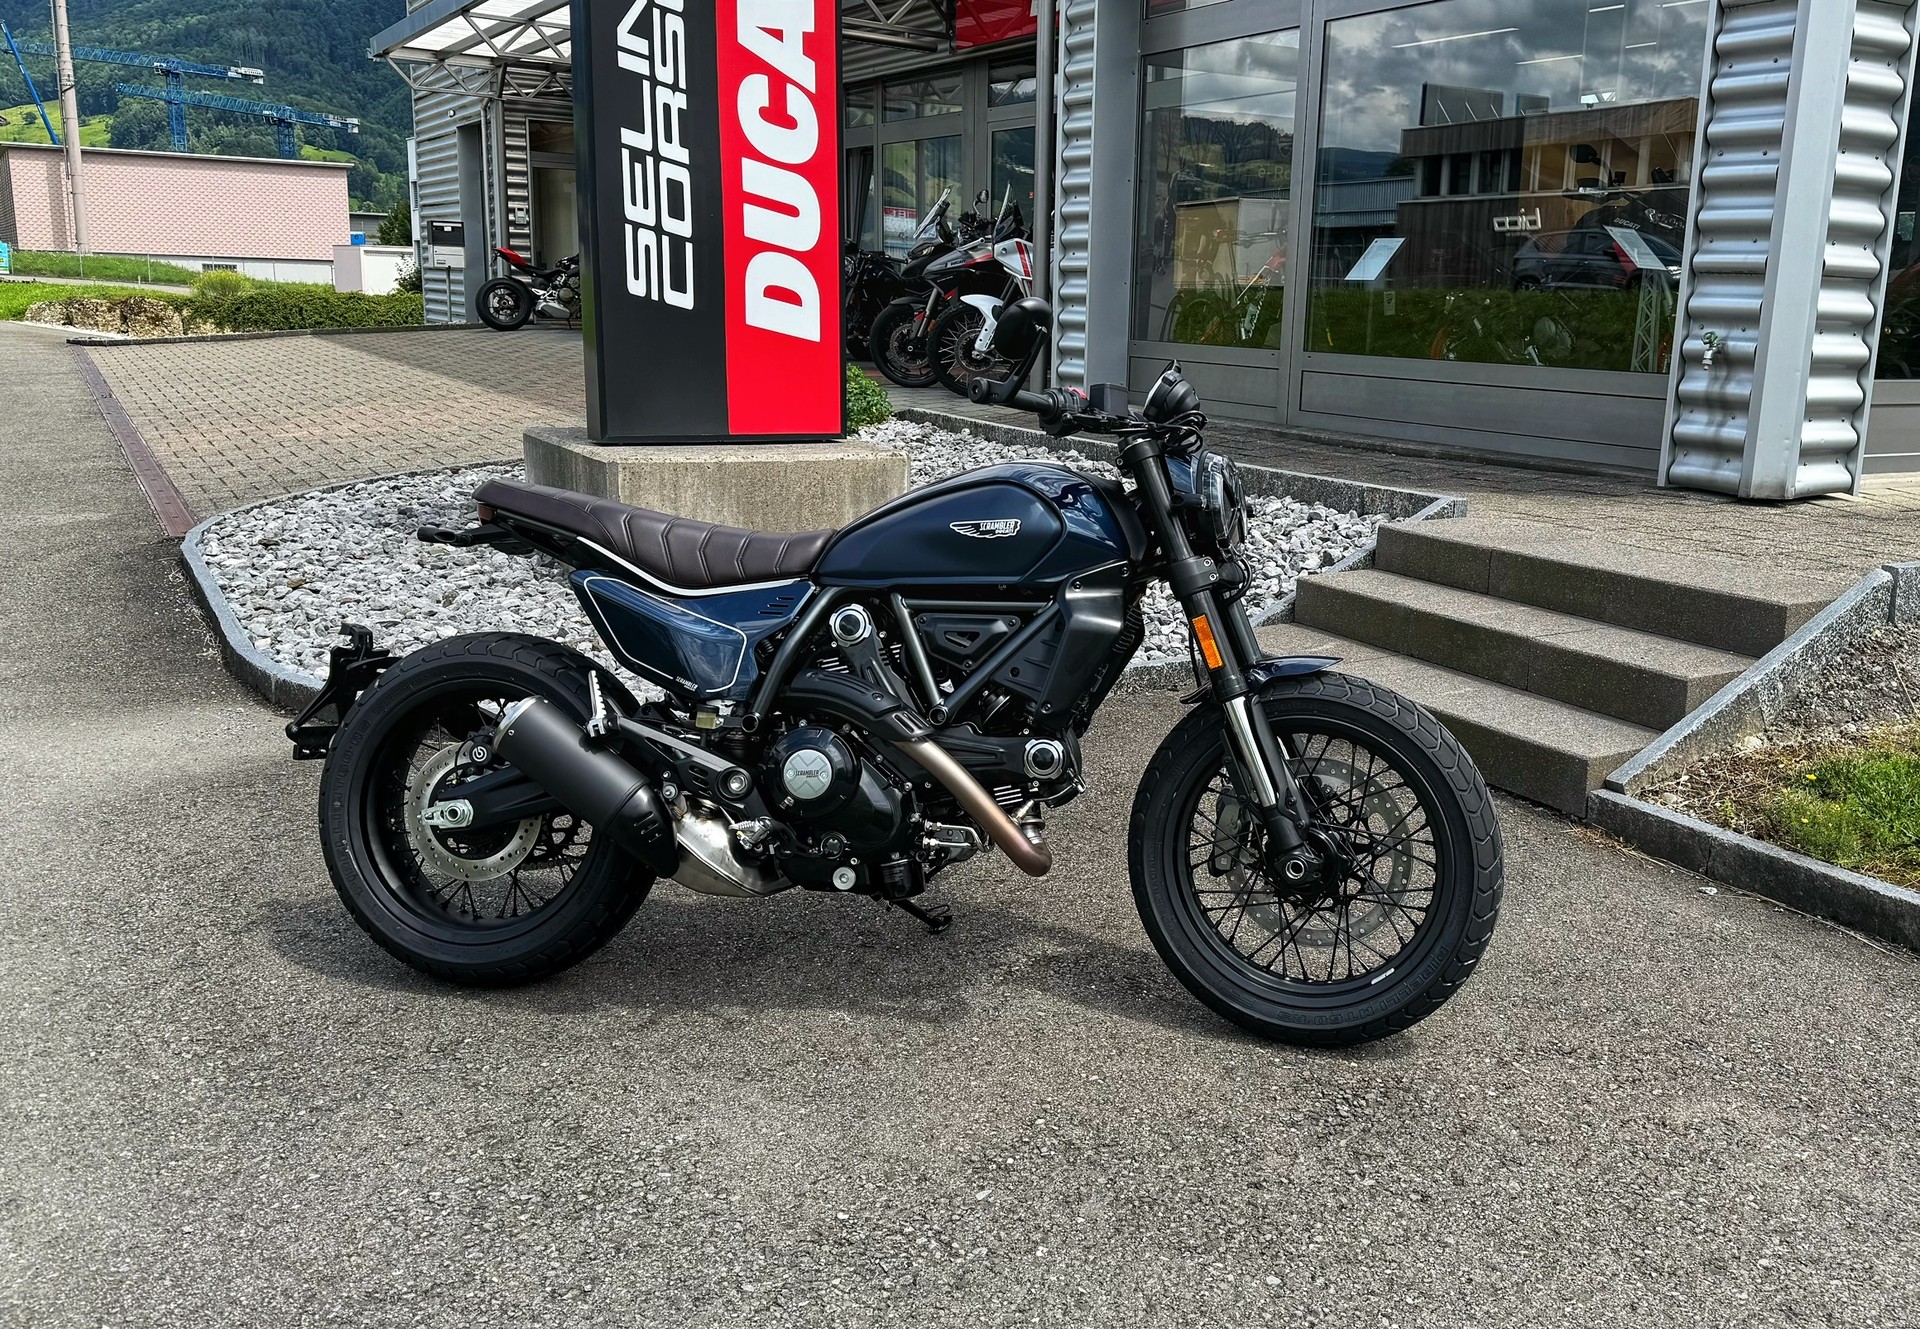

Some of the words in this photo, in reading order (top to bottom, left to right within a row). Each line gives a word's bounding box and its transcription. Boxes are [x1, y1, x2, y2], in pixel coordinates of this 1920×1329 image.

[653, 0, 695, 311] CORS
[1613, 217, 1641, 230] DUCATI
[980, 521, 1015, 531] SCRAMBLER
[1379, 945, 1450, 1011] PIRELLI
